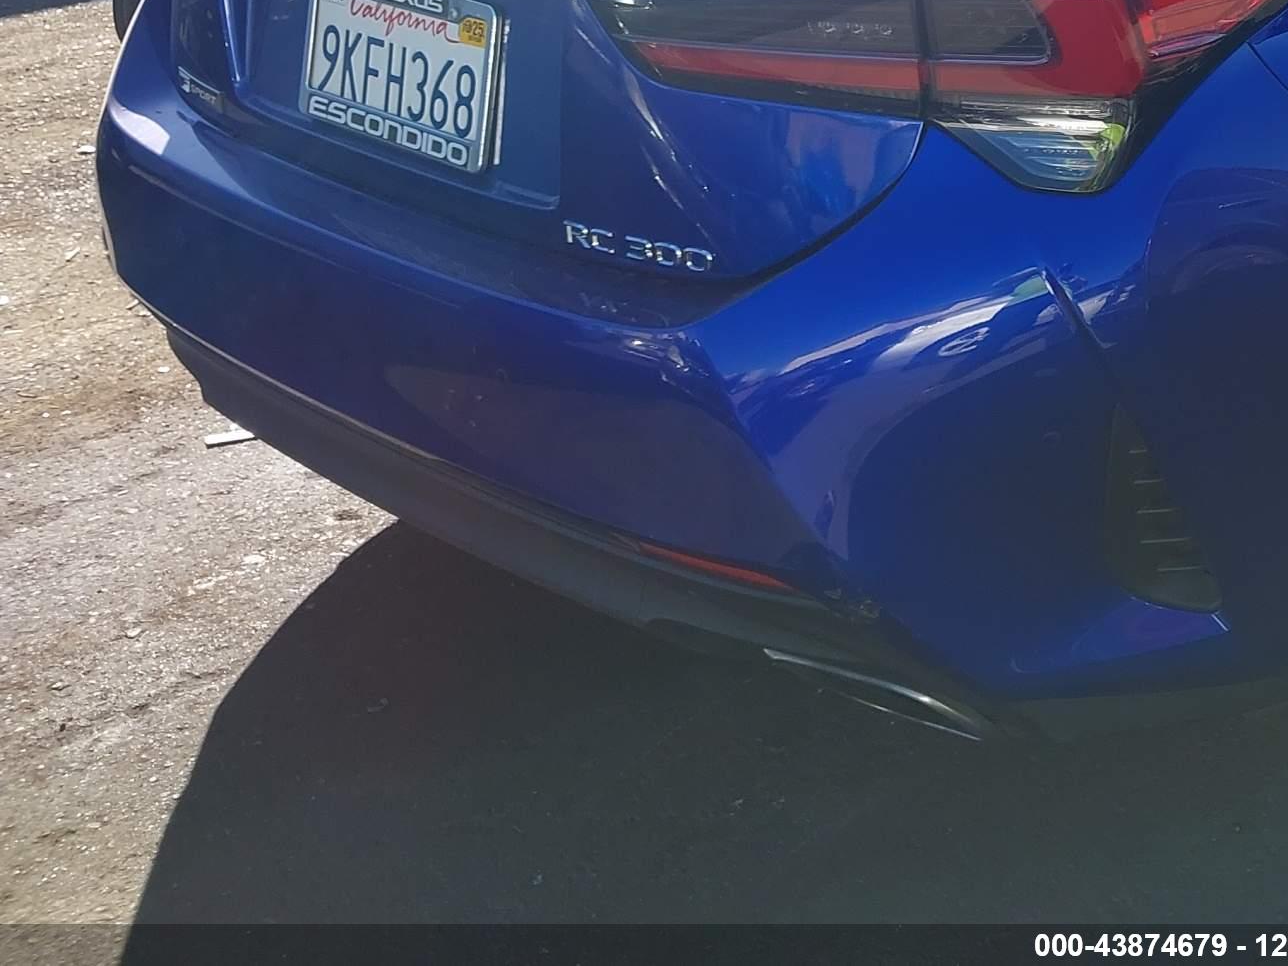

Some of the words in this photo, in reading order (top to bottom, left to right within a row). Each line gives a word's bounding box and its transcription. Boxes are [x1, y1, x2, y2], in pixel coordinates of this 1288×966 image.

[317, 24, 477, 139] 9KFH368
[308, 95, 468, 167] ESCONDIDO
[563, 219, 615, 255] RC
[625, 235, 714, 272] 300
